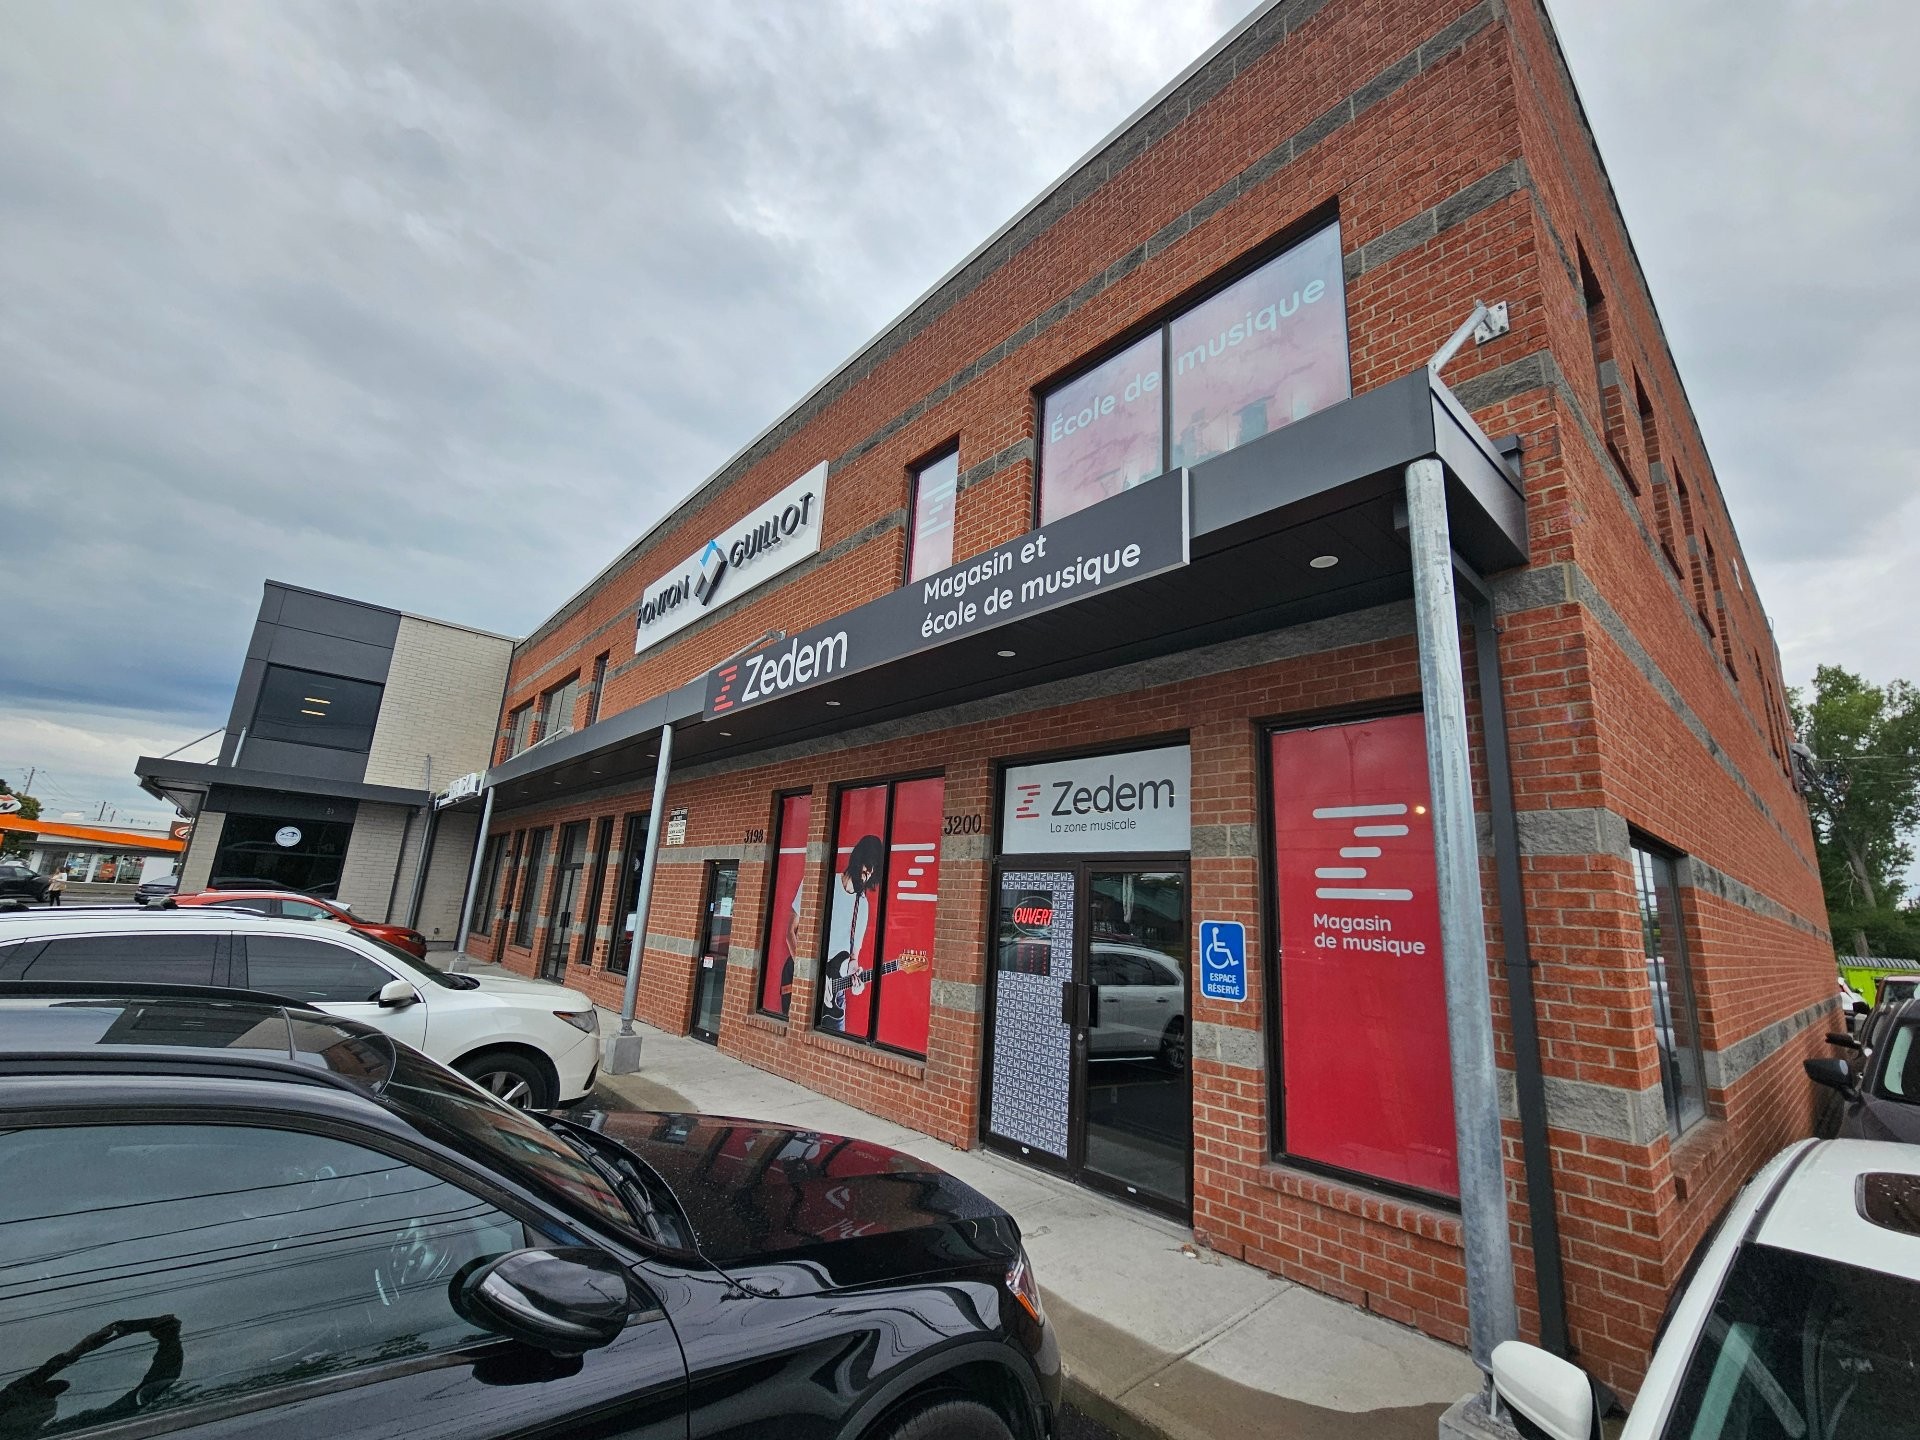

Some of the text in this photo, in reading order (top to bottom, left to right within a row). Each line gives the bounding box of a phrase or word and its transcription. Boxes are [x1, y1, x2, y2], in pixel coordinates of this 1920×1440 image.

[1051, 279, 1325, 444] École de musique
[729, 492, 814, 568] GUILLOT
[924, 534, 1046, 604] Magasin et
[921, 543, 1141, 637] école de musique
[741, 631, 848, 702] Zedem
[1052, 774, 1174, 816] Zedem
[744, 829, 764, 843] 3198
[944, 814, 982, 835] 3200
[1050, 818, 1137, 833] La zone musicale
[1013, 907, 1053, 926] OUVERT
[1313, 913, 1391, 933] Magasin
[1314, 932, 1425, 957] de musique
[1207, 983, 1240, 995] RÉSERVÉ
[1209, 973, 1237, 983] ESPACE
